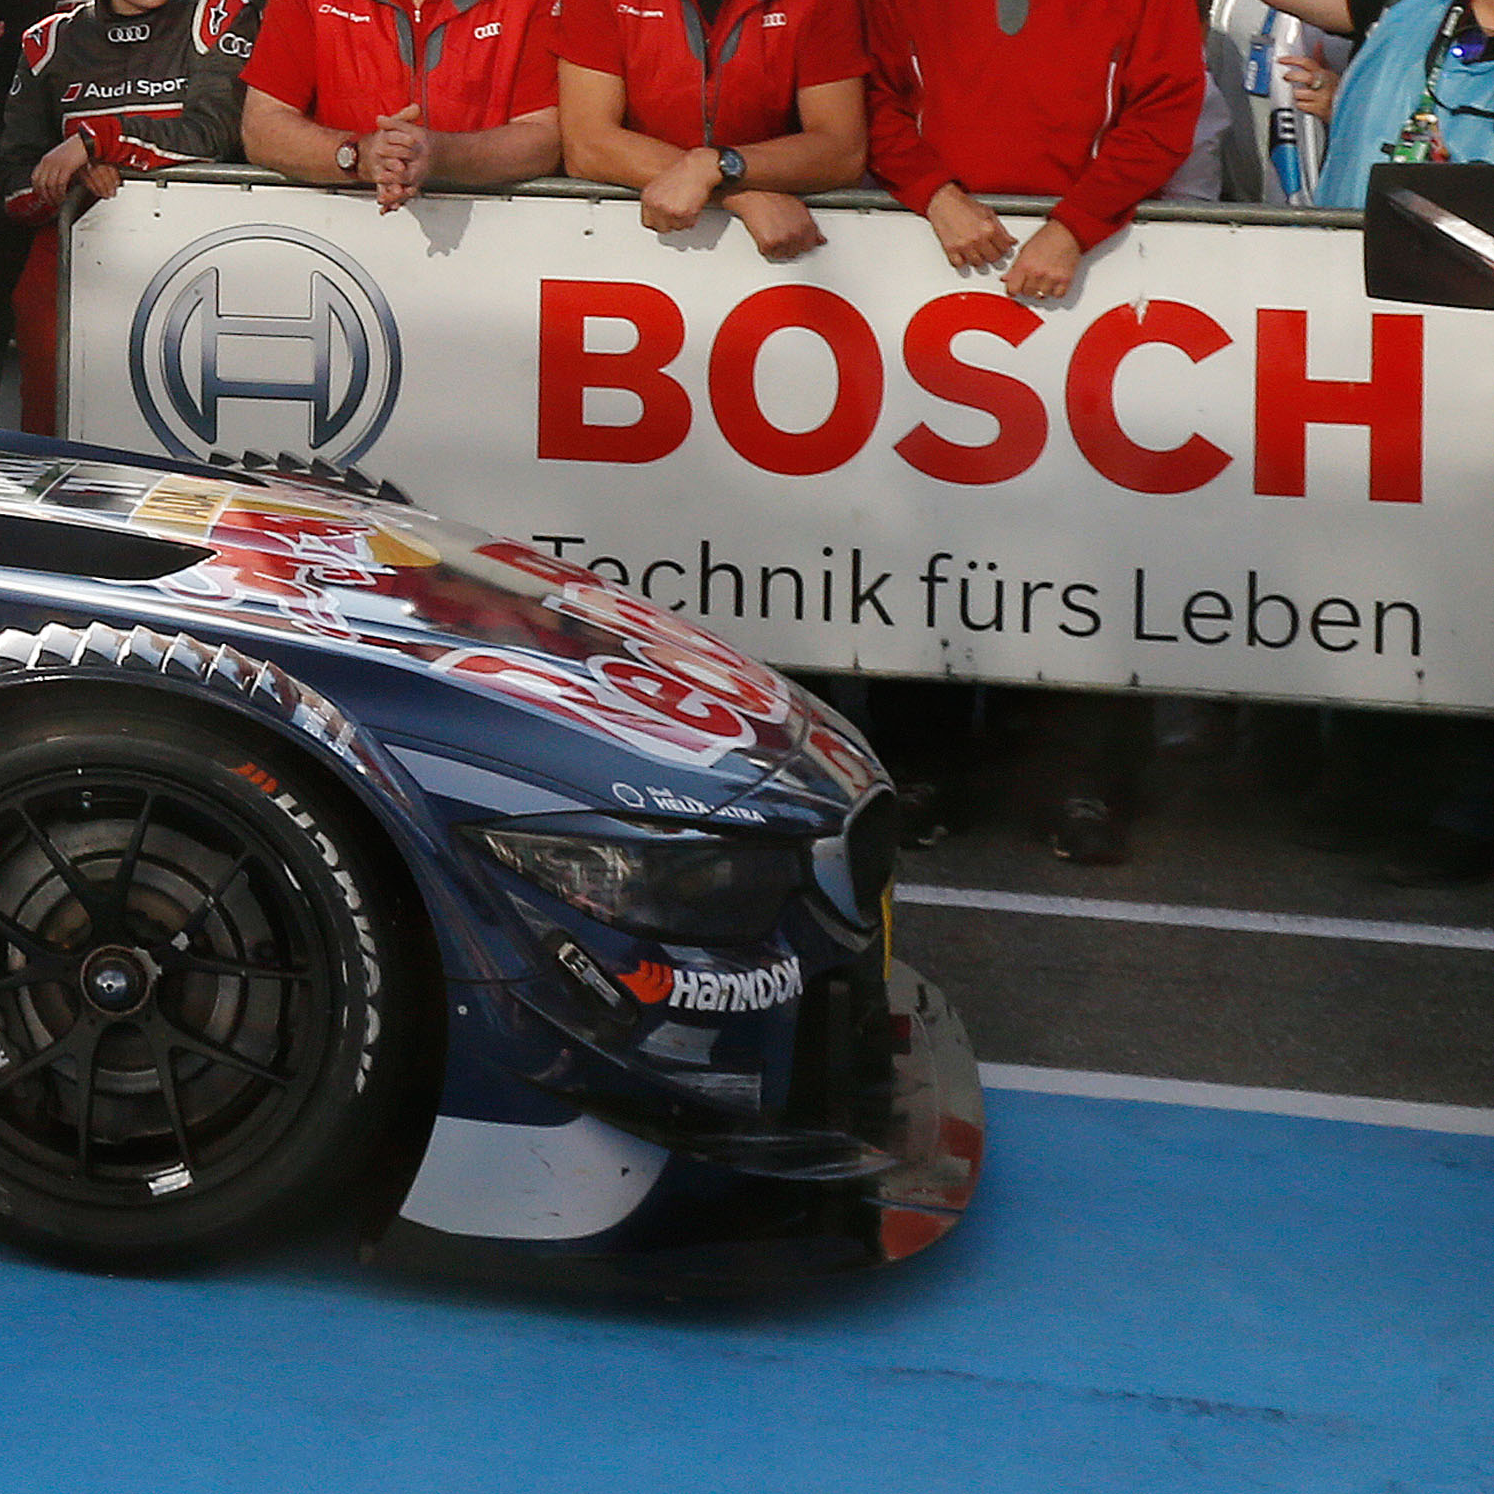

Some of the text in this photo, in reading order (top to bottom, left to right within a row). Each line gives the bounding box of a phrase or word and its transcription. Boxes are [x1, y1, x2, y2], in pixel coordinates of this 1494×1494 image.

[83, 78, 189, 99] Audi Spor
[535, 277, 1425, 504] BOSCH
[531, 534, 1423, 656] Technik fürs Leben
